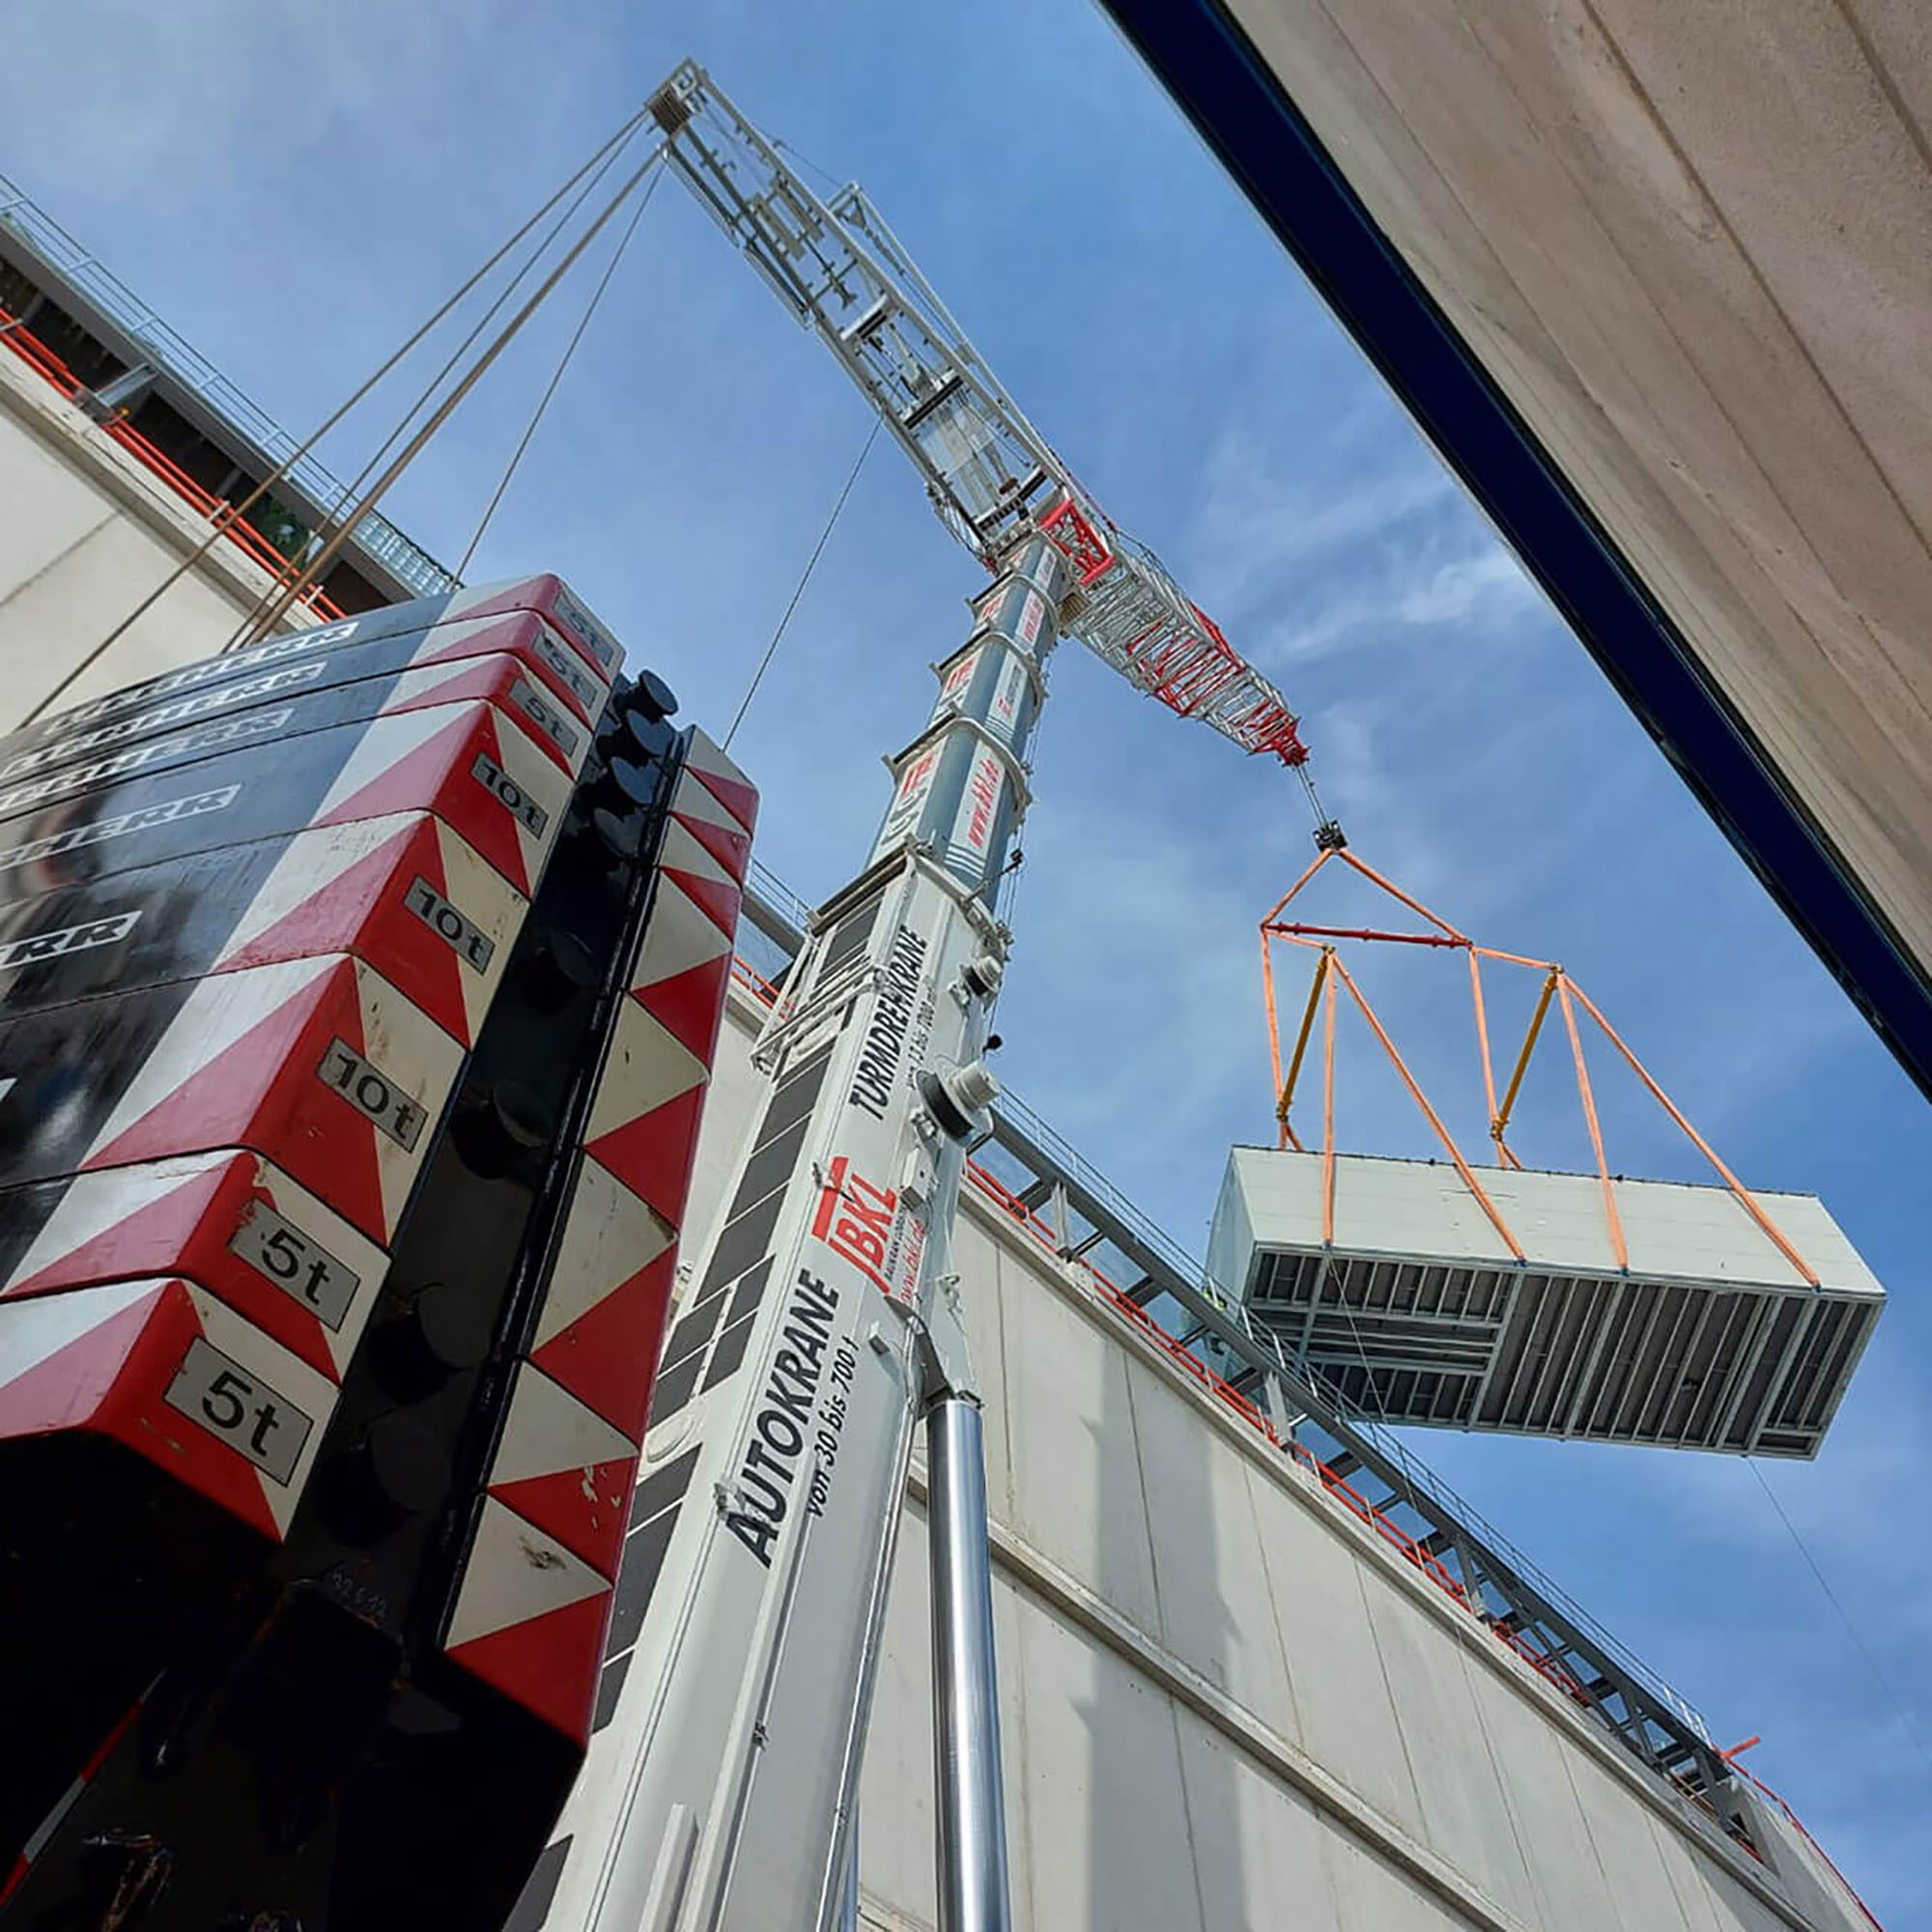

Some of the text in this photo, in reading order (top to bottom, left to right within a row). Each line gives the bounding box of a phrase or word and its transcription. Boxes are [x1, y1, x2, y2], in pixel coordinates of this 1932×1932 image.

[526, 696, 564, 743] 5t
[482, 762, 541, 826] 10t
[0, 910, 143, 969] RR
[418, 887, 486, 964] 10t
[849, 924, 927, 1121] TURMDREHKRANE
[336, 1052, 415, 1140] 10t
[261, 1228, 331, 1305] 5t
[202, 1370, 279, 1457] 5t
[725, 1267, 839, 1569] AUTOKRANE
[807, 1335, 859, 1517] von 30 bis 700 t
